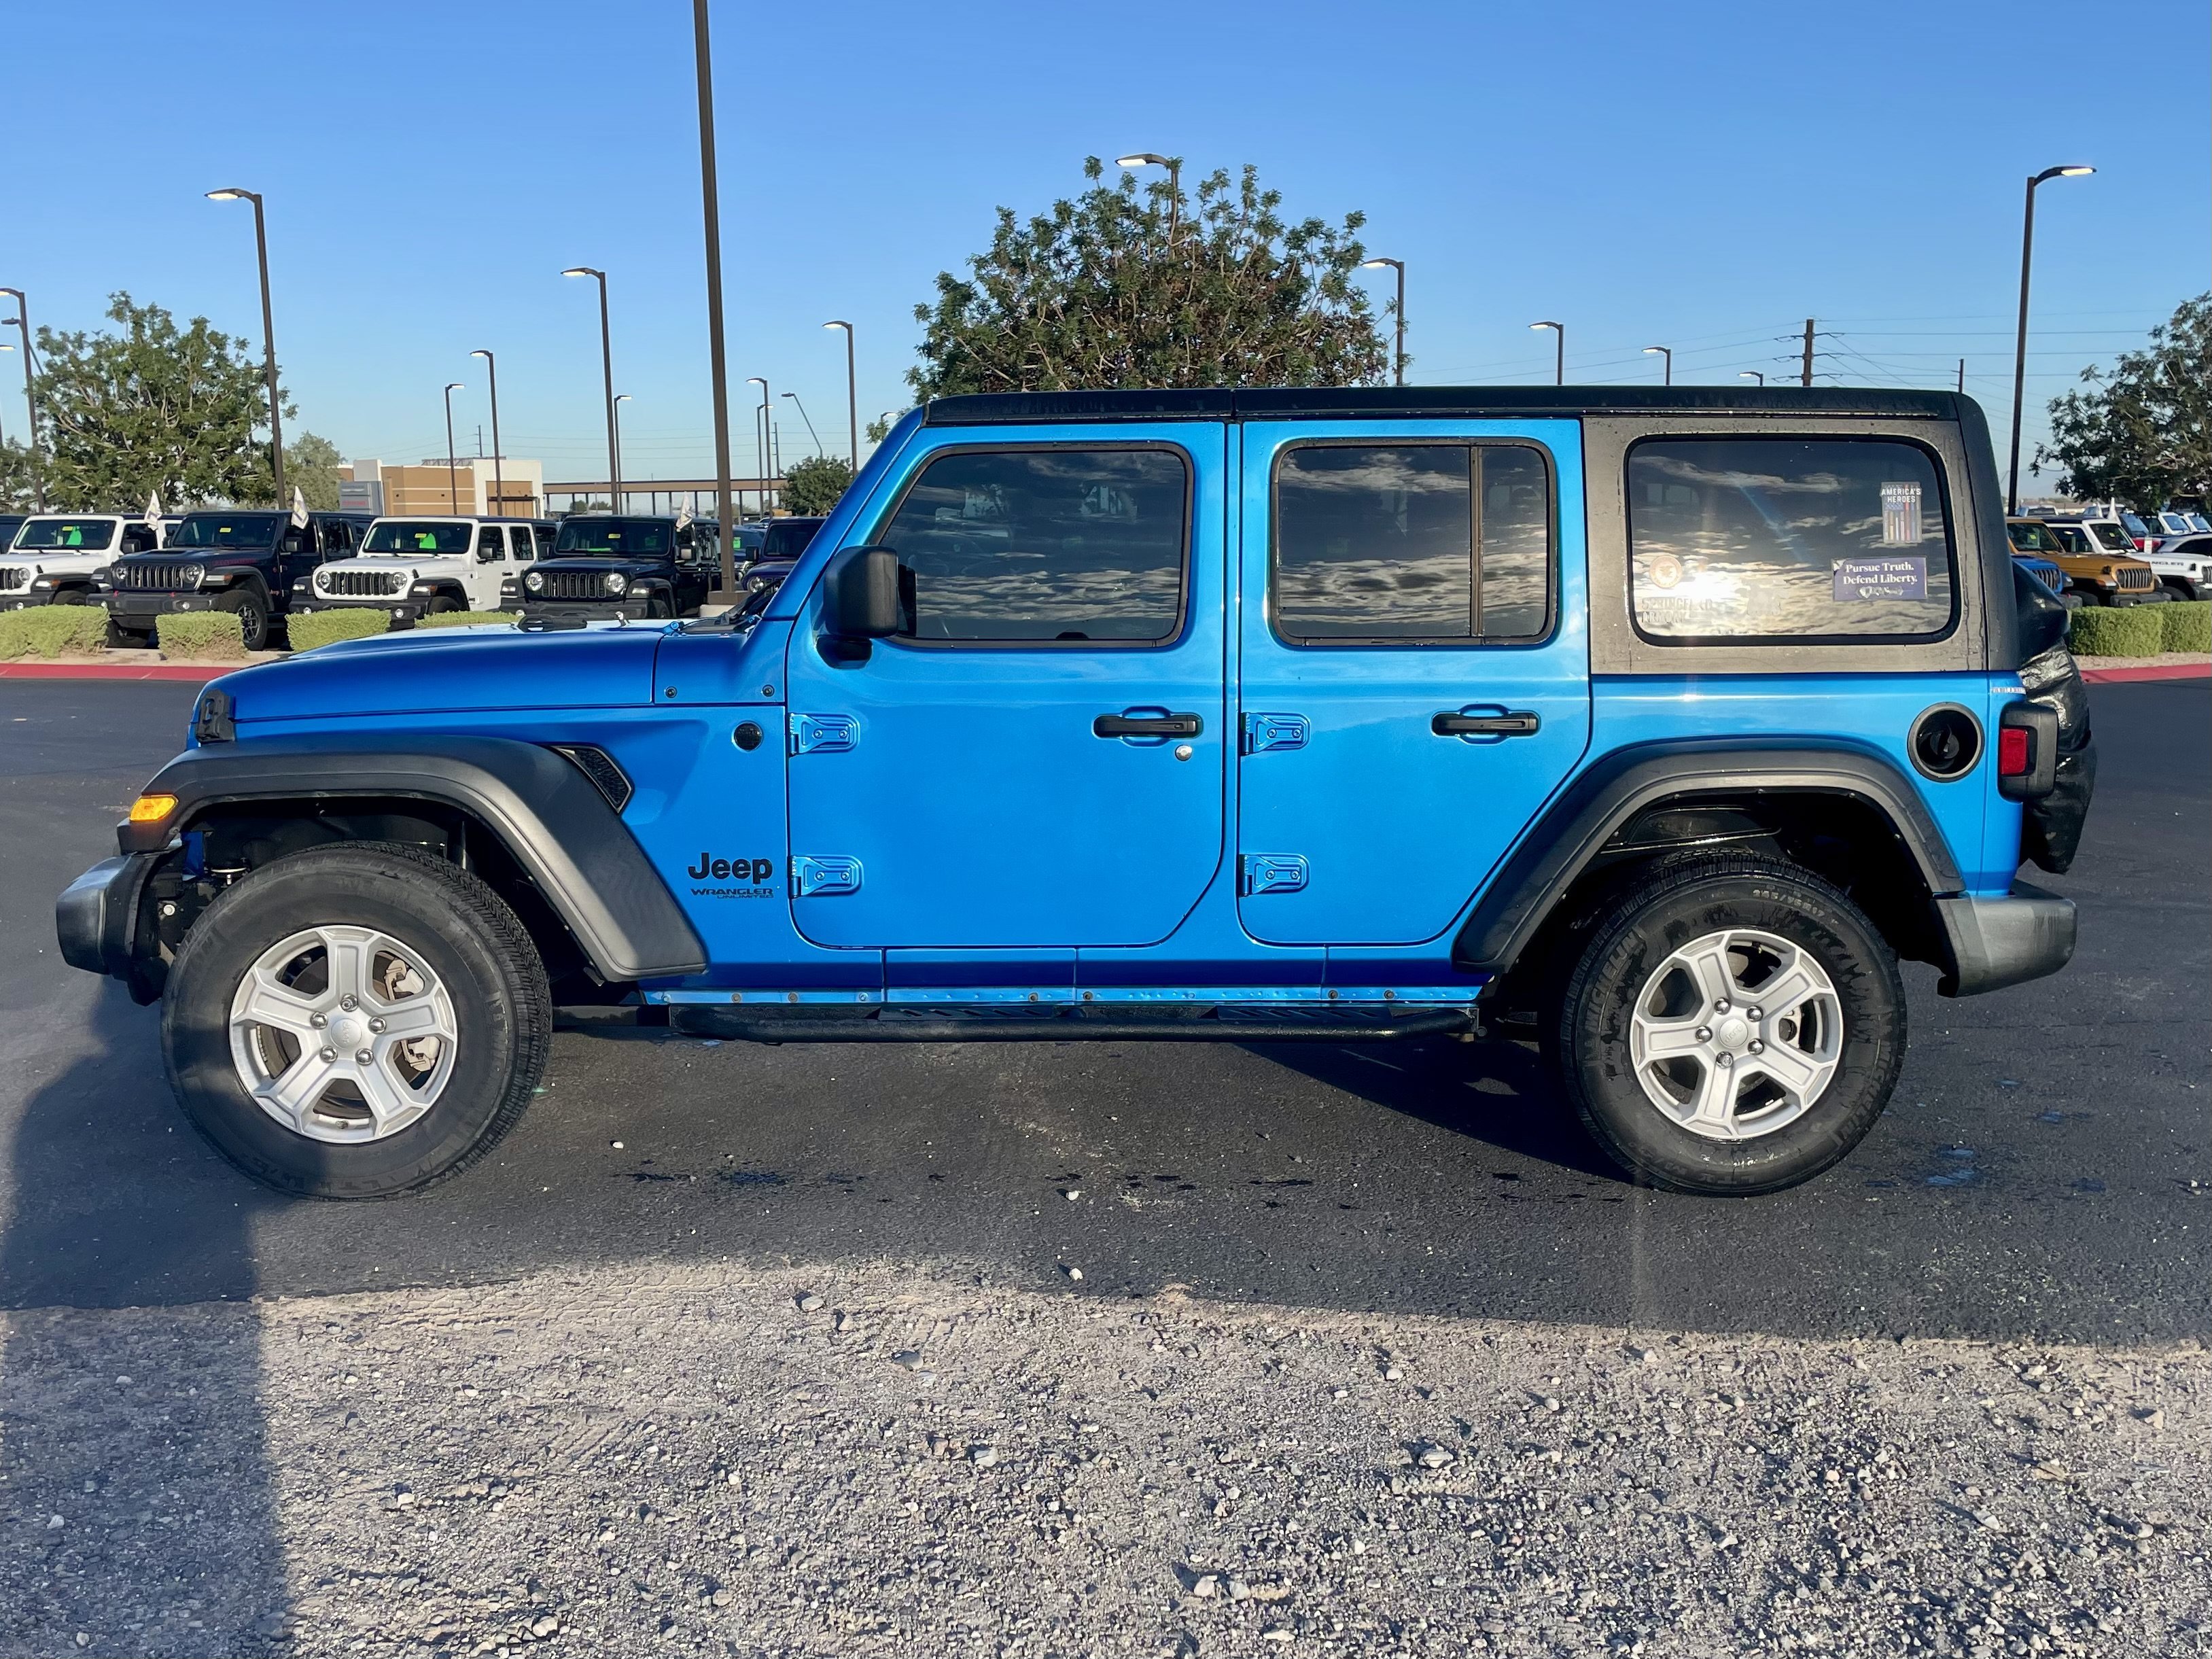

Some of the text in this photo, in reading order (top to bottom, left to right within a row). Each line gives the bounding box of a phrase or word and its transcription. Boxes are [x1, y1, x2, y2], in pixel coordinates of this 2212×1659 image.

[1881, 487, 1922, 496] AMERICA'S
[1846, 561, 1914, 573] Pursue Truth.
[1843, 574, 1918, 585] Defend Liberty.
[688, 852, 773, 885] Jeep
[690, 888, 773, 896] WRANGLER
[1584, 930, 1638, 1036] MICHELIN
